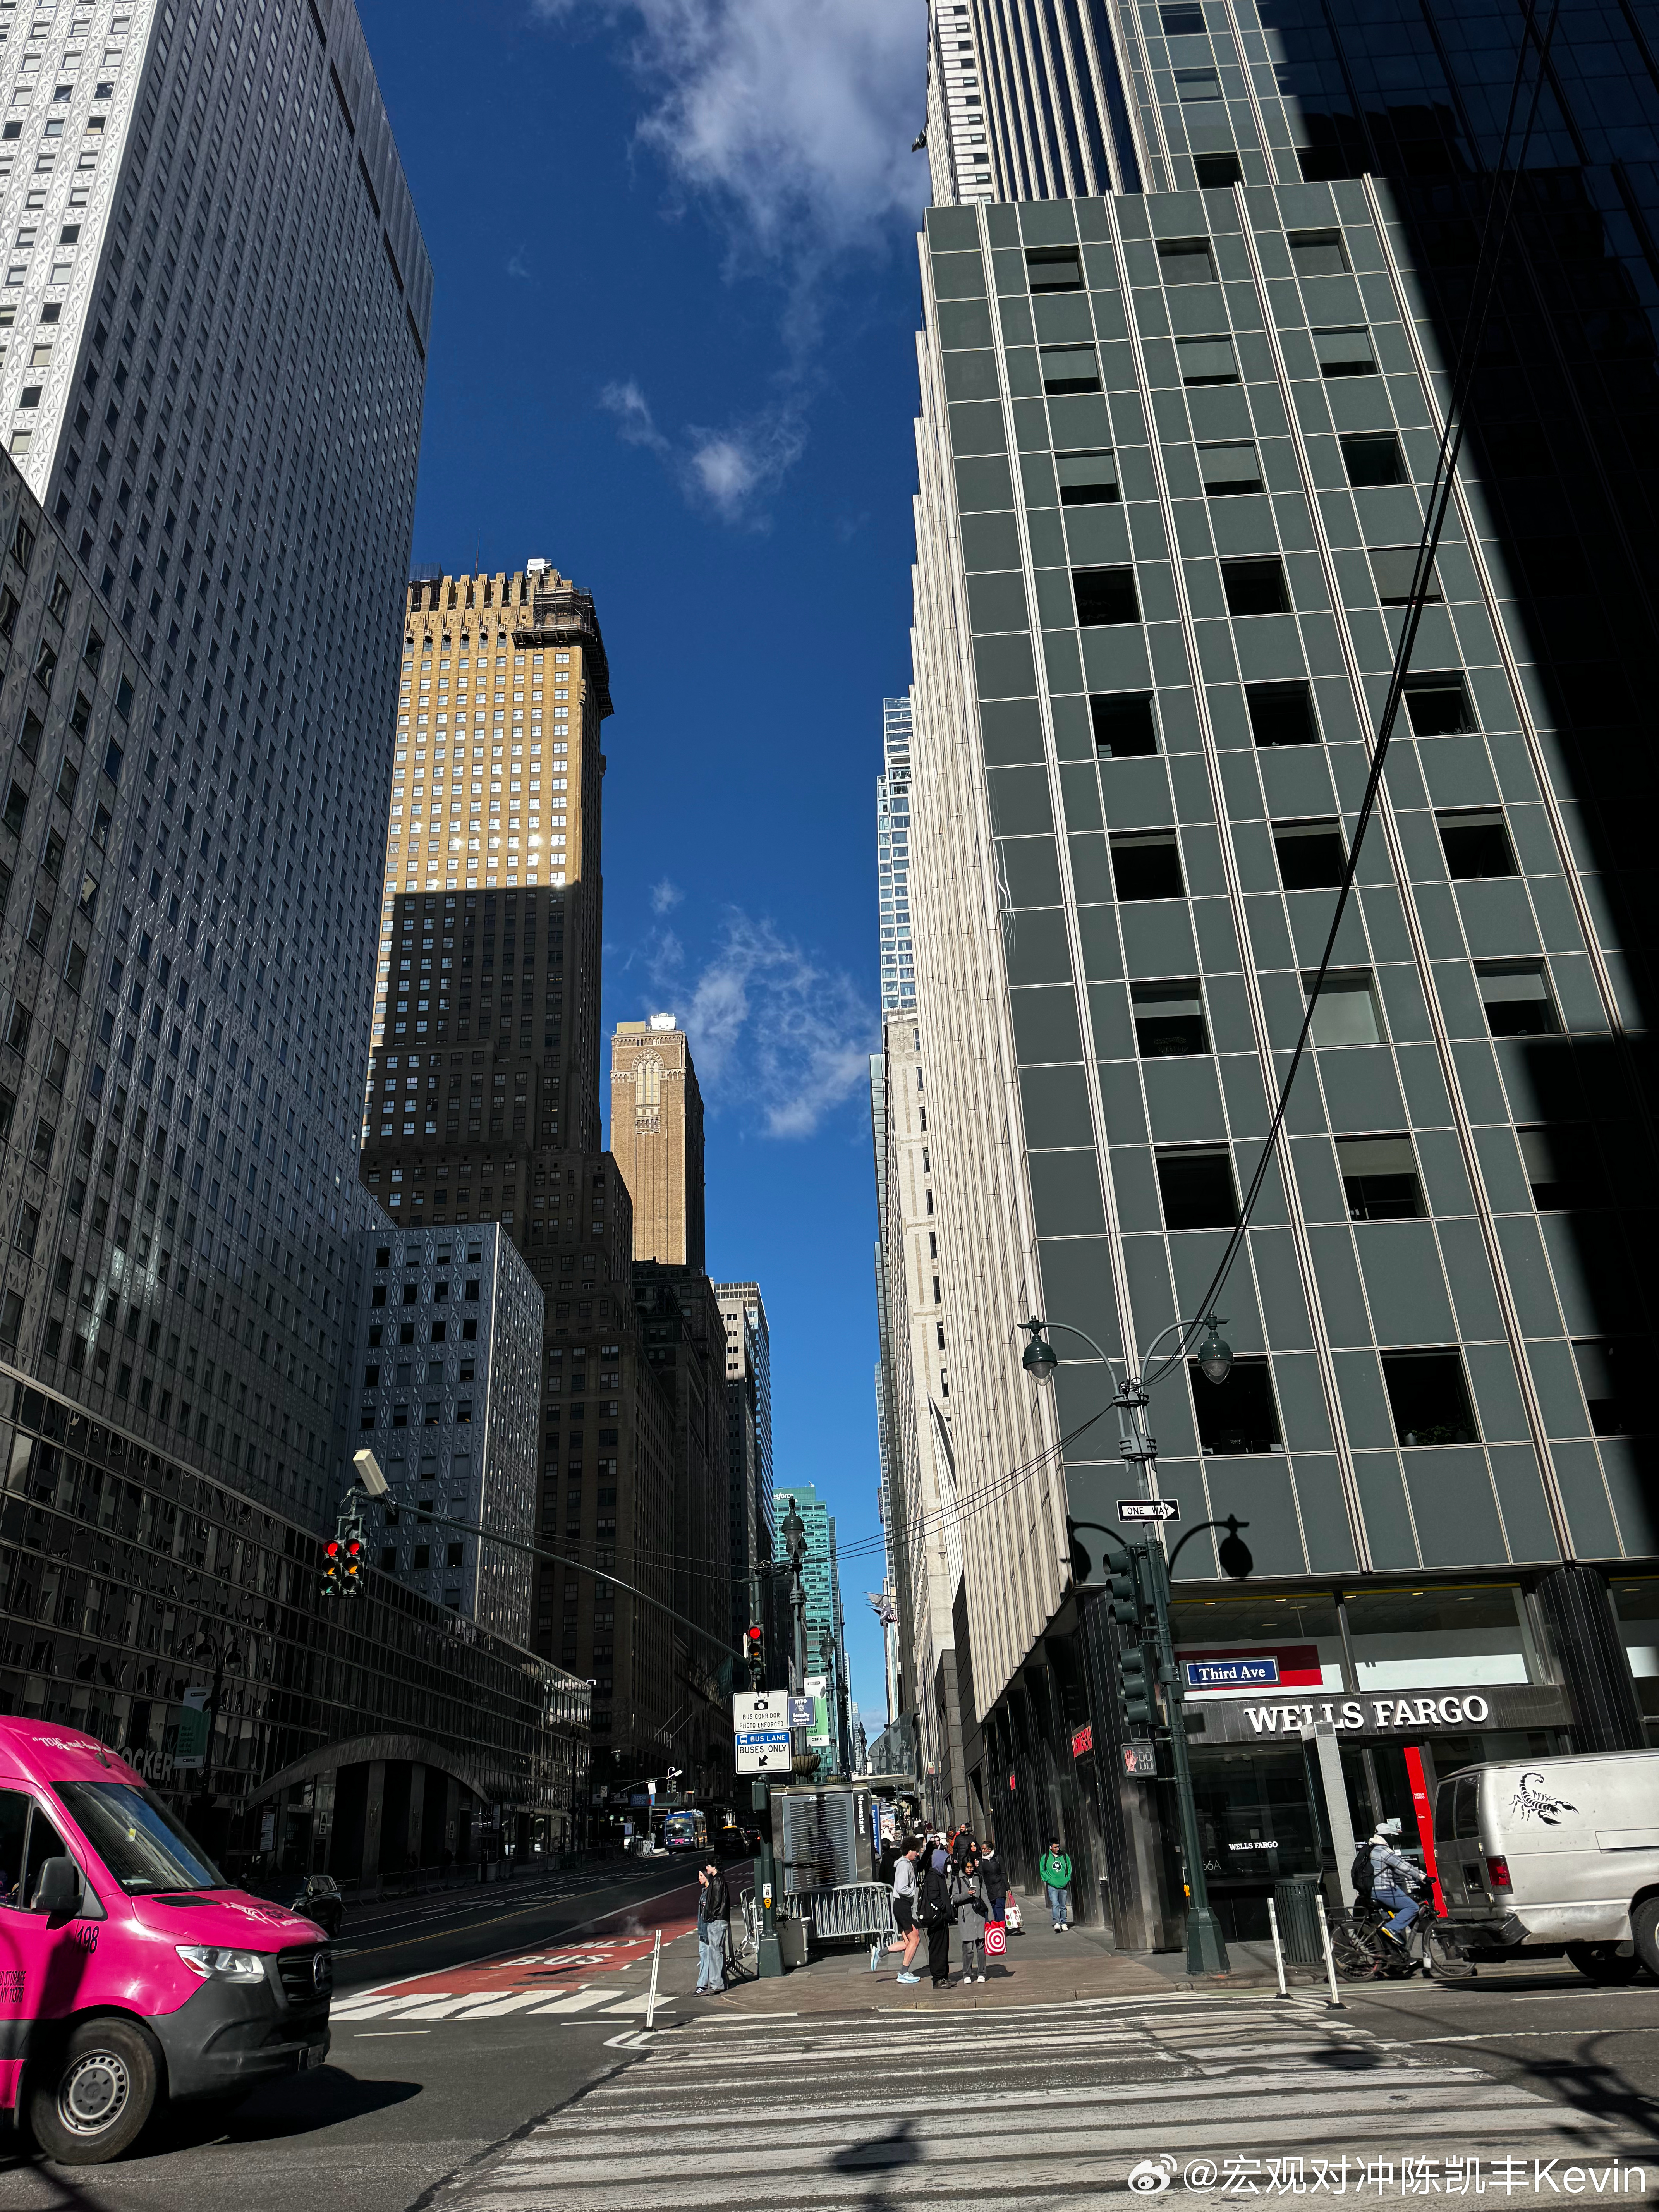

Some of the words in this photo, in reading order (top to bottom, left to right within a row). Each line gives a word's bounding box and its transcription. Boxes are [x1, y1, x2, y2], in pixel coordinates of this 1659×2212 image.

[1152, 1507, 1169, 1515] WAY
[1199, 1666, 1237, 1680] Third
[1241, 1666, 1266, 1678] Ave
[1244, 1702, 1364, 1733] WELLS
[1373, 1695, 1489, 1726] FARGO
[121, 1747, 173, 1782] OCKER
[77, 1925, 100, 1954] 198
[544, 1939, 653, 1950] ONLY
[498, 1954, 614, 1966] BUS
[4, 1970, 27, 1986] STORAGE
